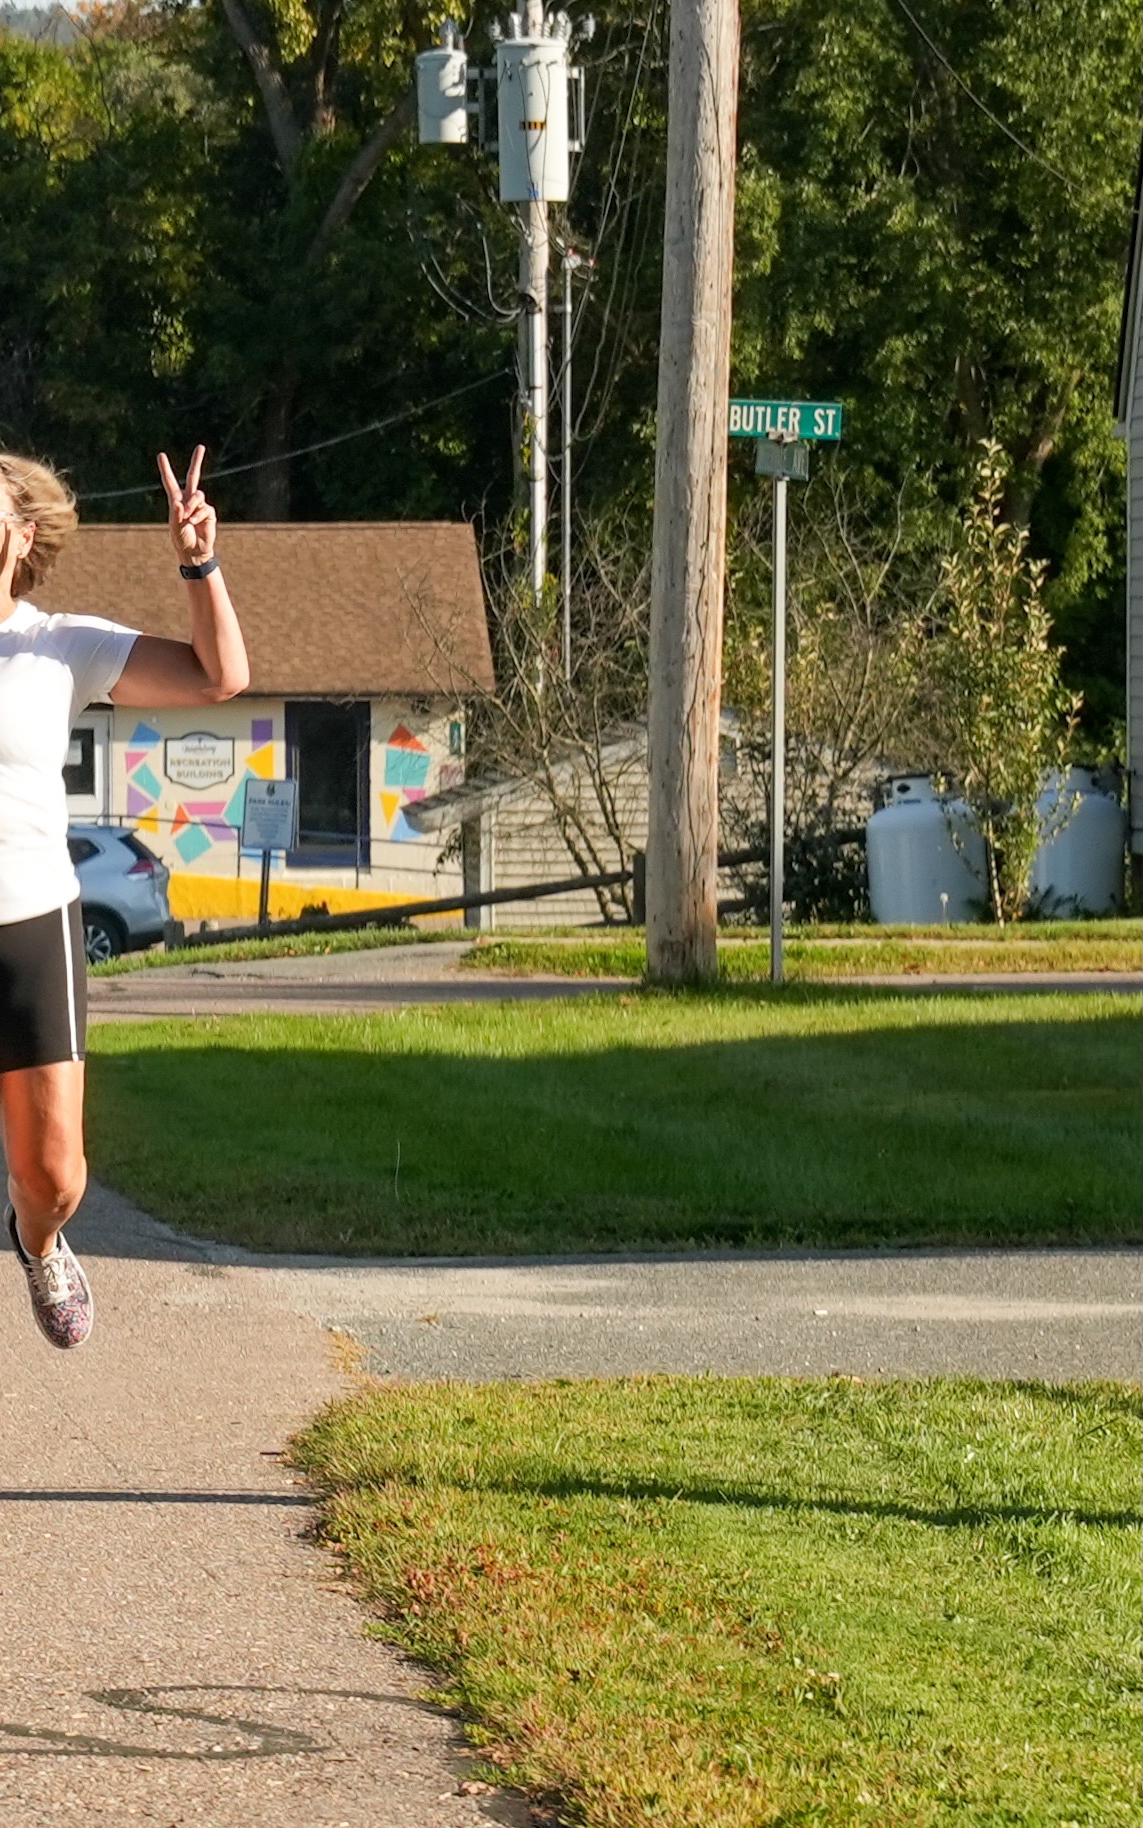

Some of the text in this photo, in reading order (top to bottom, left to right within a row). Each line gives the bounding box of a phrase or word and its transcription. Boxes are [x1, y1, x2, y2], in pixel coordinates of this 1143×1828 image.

[729, 404, 836, 435] BUTLER ST
[170, 758, 231, 767] RECREATION
[176, 770, 224, 778] BUILDING
